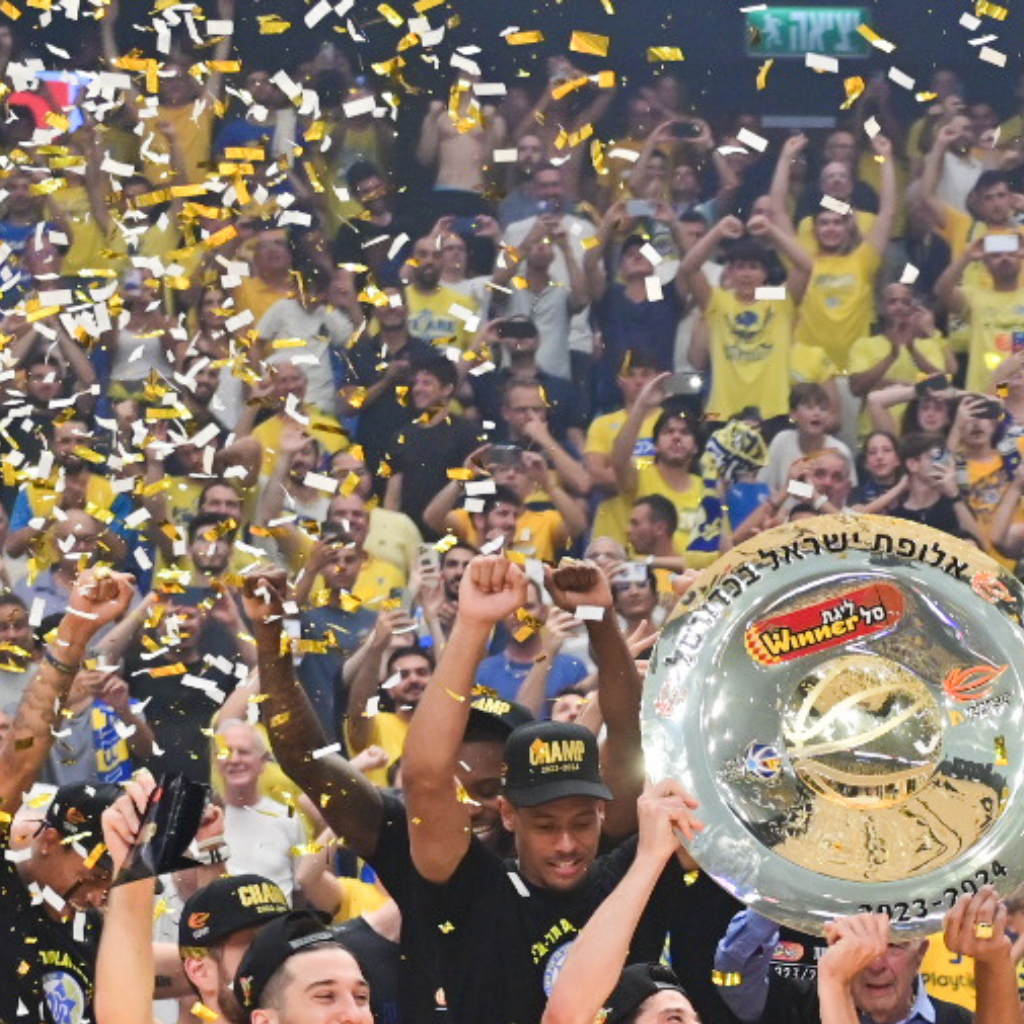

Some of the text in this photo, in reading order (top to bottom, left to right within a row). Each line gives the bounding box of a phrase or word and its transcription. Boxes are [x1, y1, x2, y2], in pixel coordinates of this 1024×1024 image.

[759, 532, 860, 570] ישראל
[873, 533, 969, 579] אלופת
[761, 605, 886, 655] סל Winner
